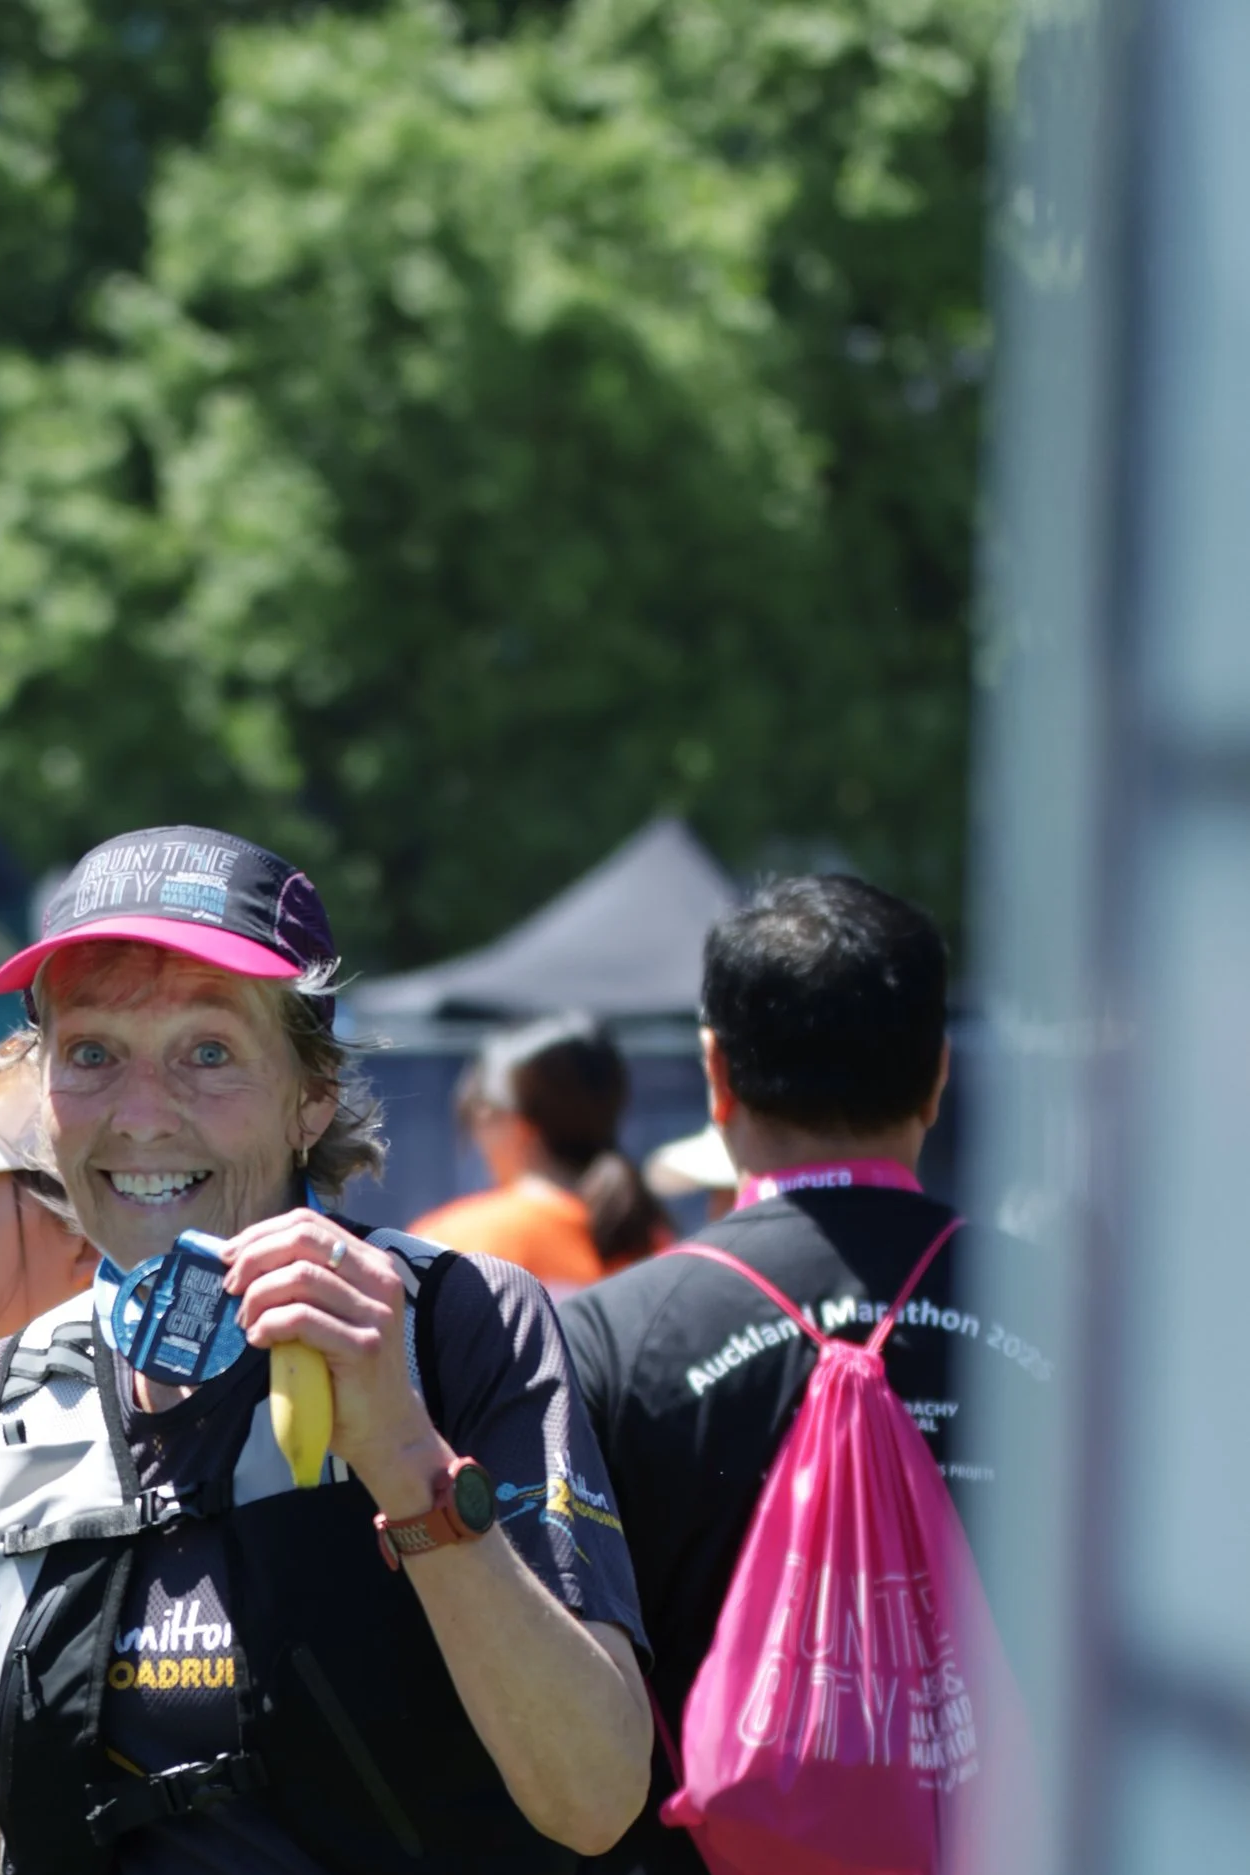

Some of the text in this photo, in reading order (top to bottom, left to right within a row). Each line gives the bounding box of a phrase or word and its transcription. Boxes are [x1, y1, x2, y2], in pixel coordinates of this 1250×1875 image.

[81, 843, 157, 885] RUN
[161, 841, 239, 878] THE
[73, 871, 163, 918] CITY
[165, 1310, 218, 1344] CITY
